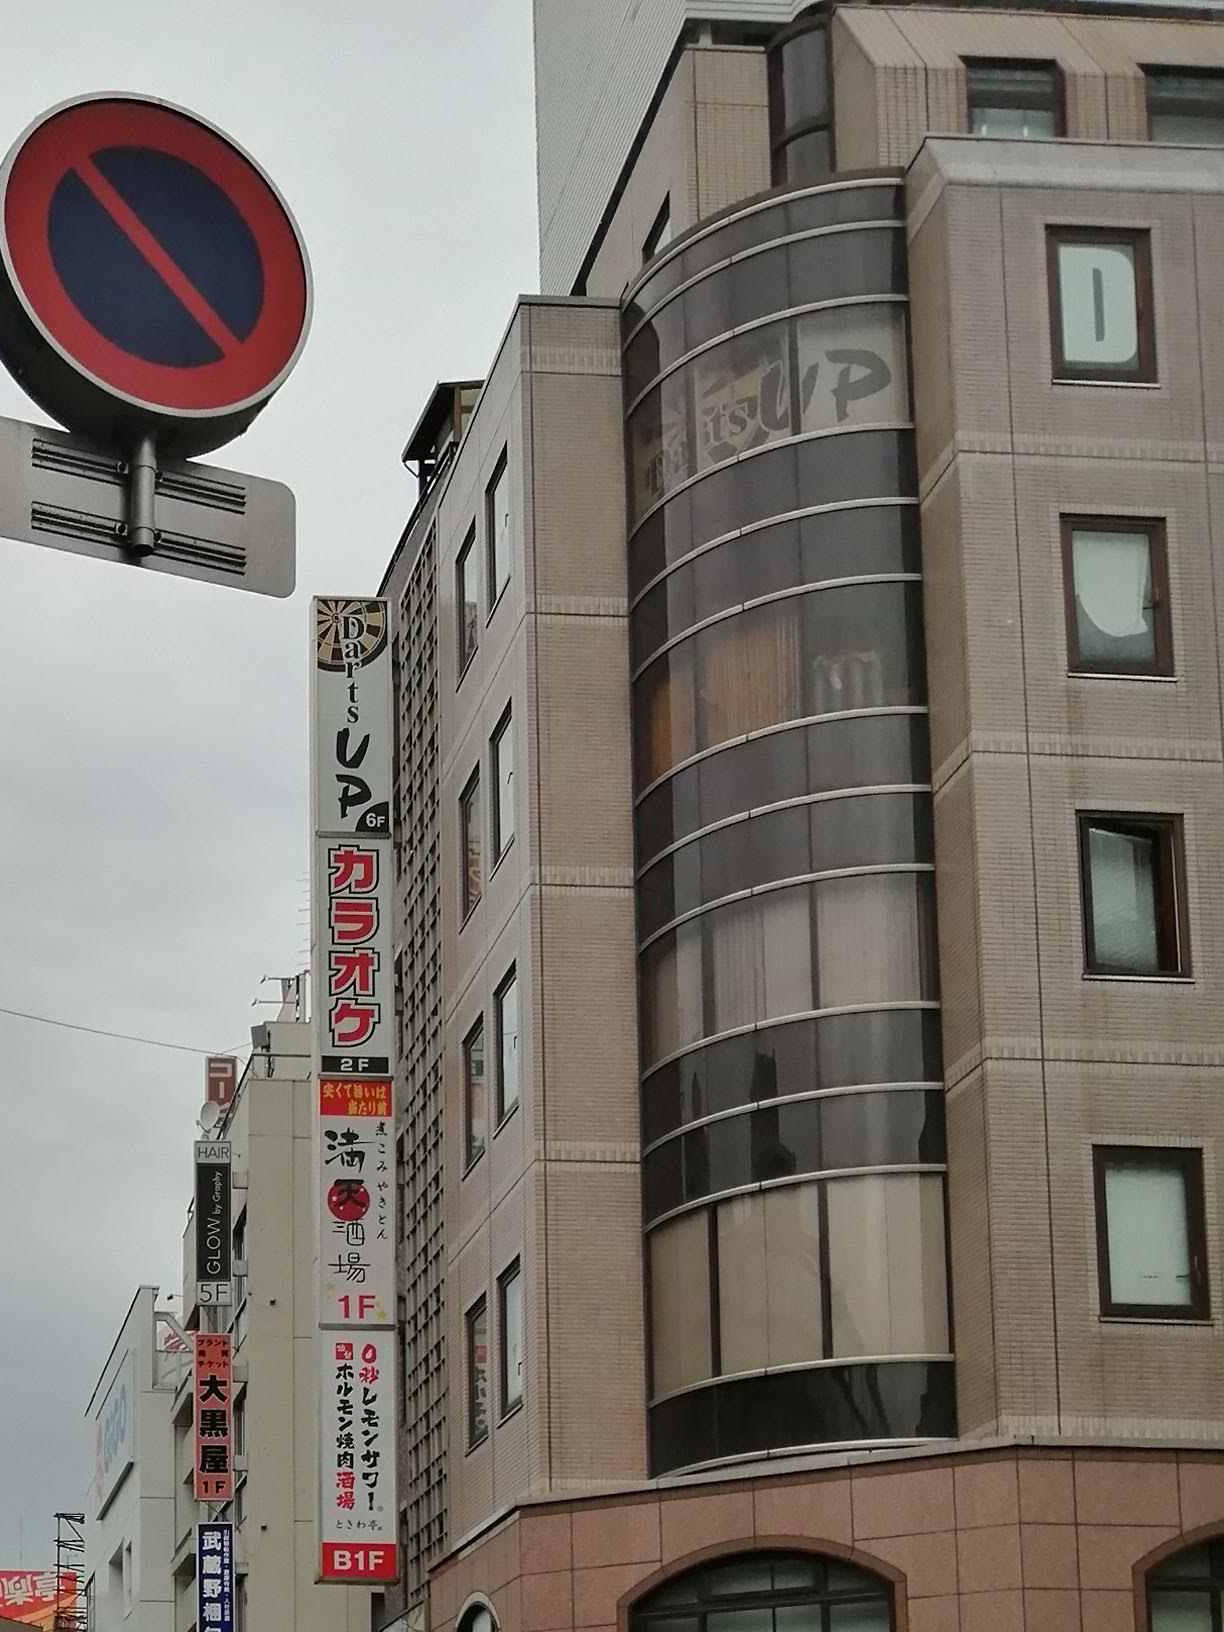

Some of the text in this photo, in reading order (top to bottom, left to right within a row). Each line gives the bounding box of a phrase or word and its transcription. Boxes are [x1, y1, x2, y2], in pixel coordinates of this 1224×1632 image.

[335, 616, 372, 818] Darts UP
[366, 813, 385, 828] 6F
[329, 845, 380, 1047] カラオケ
[340, 1058, 369, 1072] 2F
[198, 1147, 230, 1159] HAIR
[376, 1121, 388, 1240] 煮こみやきとん
[206, 1170, 223, 1275] GLOW by Graphy
[199, 1283, 229, 1303] 5F
[338, 1295, 376, 1319] 1F
[199, 1374, 229, 1474] 大黒屋
[336, 1363, 356, 1511] ホルモン焼肉酒場
[202, 1480, 226, 1493] 1F
[333, 1550, 385, 1572] B1F
